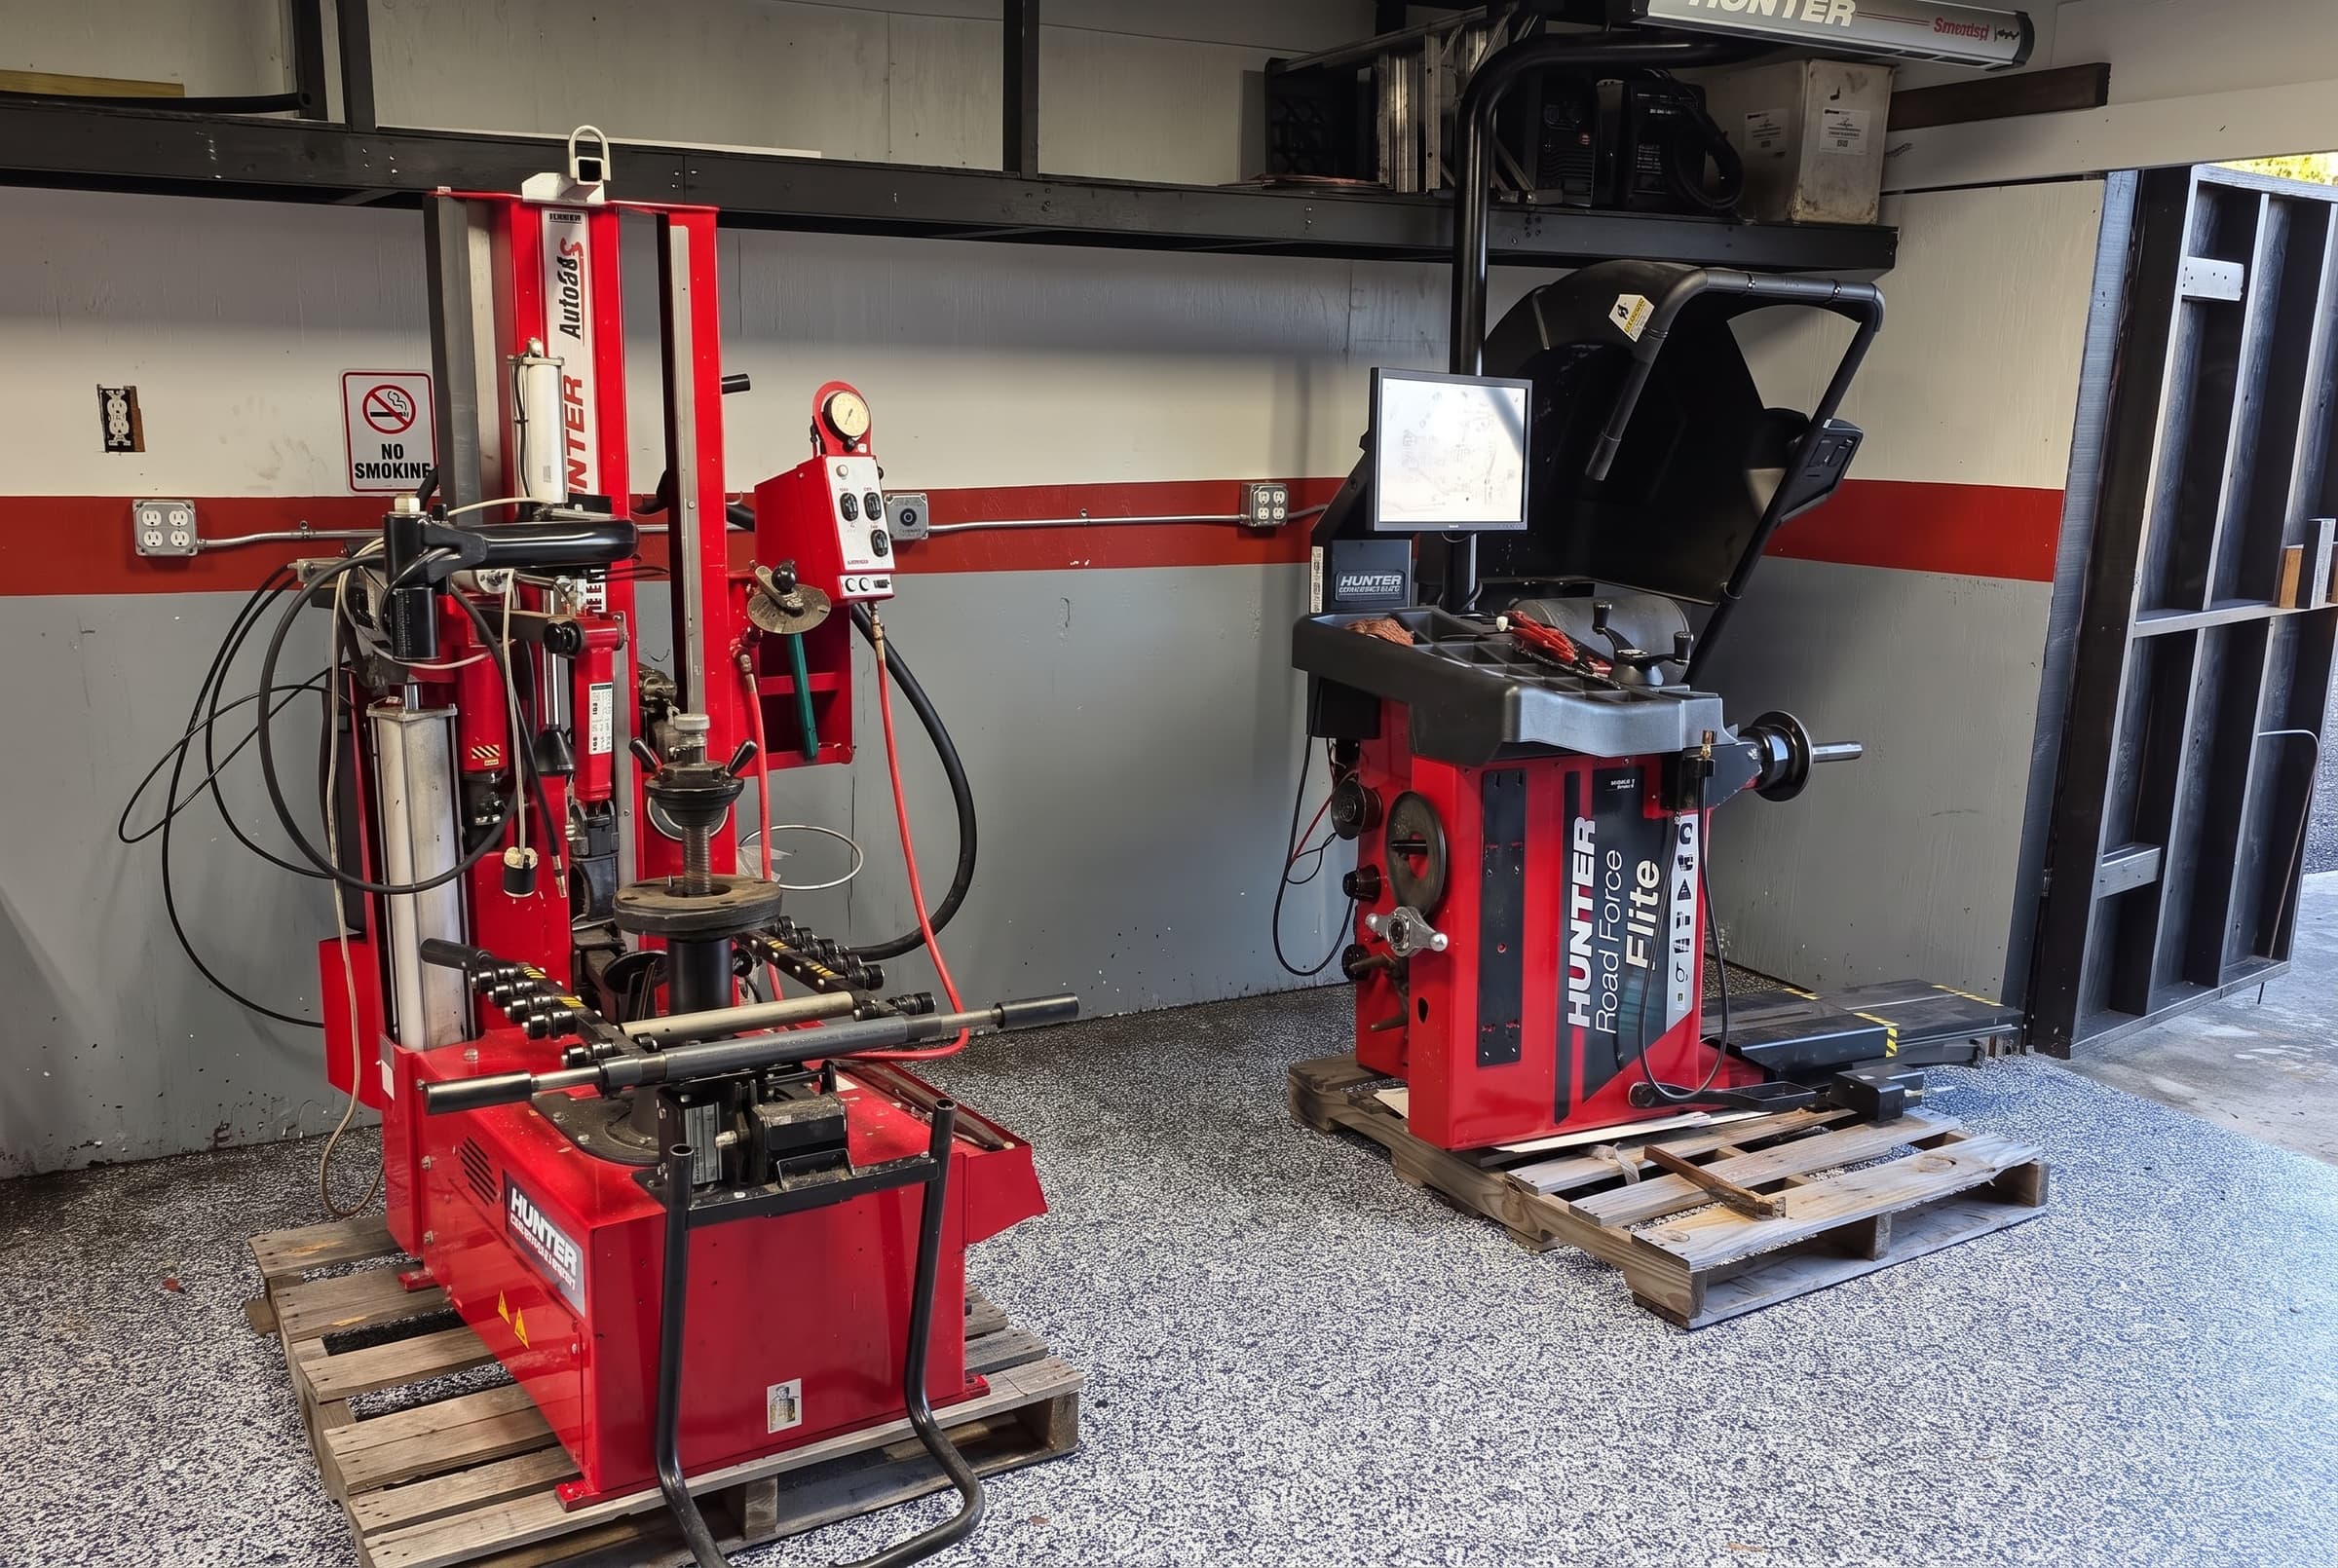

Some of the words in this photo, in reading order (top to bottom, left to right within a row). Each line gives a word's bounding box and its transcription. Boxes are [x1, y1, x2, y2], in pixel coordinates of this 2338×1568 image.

[1688, 0, 1856, 27] NTER
[381, 443, 404, 460] NO
[563, 375, 587, 493] NTER
[1339, 575, 1402, 586] HUNTER
[1567, 816, 1596, 1028] HUNTER
[1599, 849, 1622, 942] Force
[1596, 949, 1619, 1034] Road
[510, 1187, 578, 1277] HUNTER
